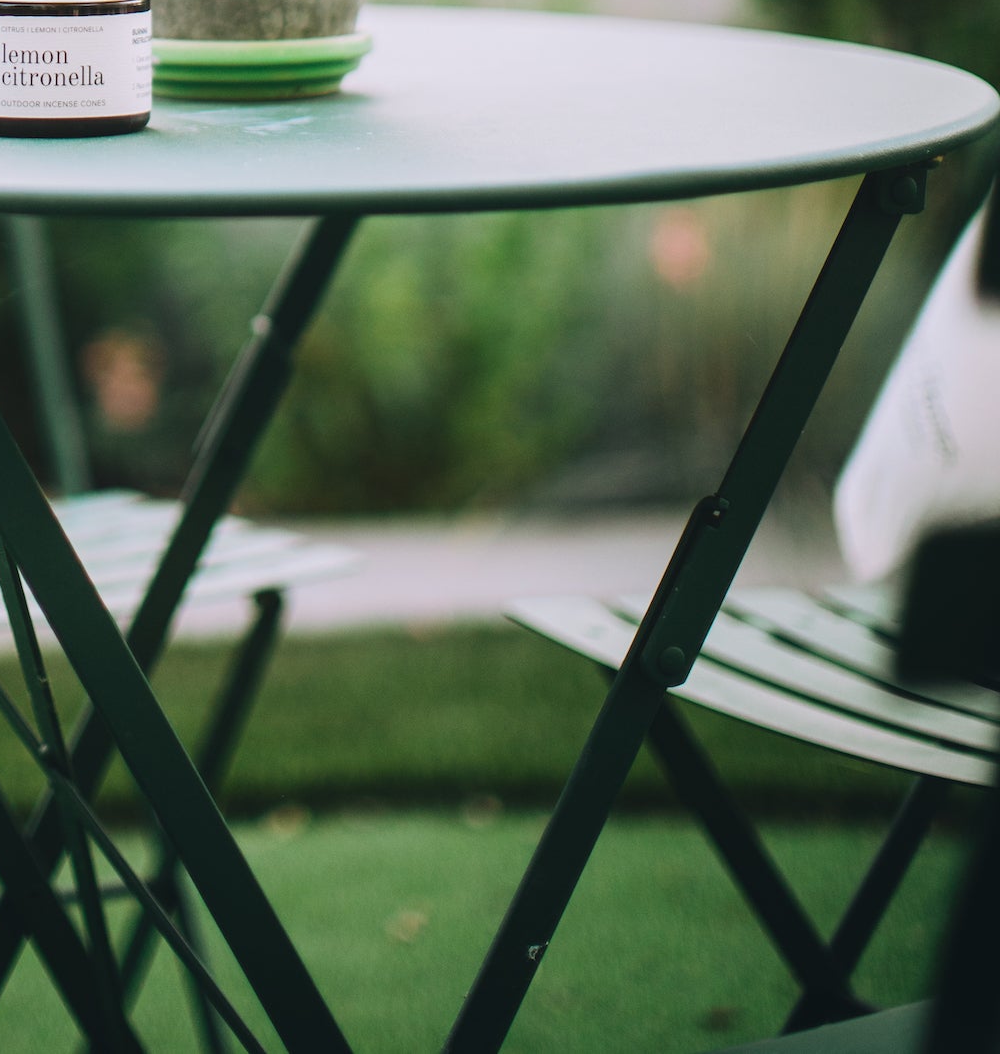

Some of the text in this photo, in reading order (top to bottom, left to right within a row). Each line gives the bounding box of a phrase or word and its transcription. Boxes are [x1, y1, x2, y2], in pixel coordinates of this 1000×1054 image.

[2, 43, 68, 64] lemon
[2, 65, 104, 87] citronella
[1, 99, 106, 108] OUTDOOR INCENSE CONES
